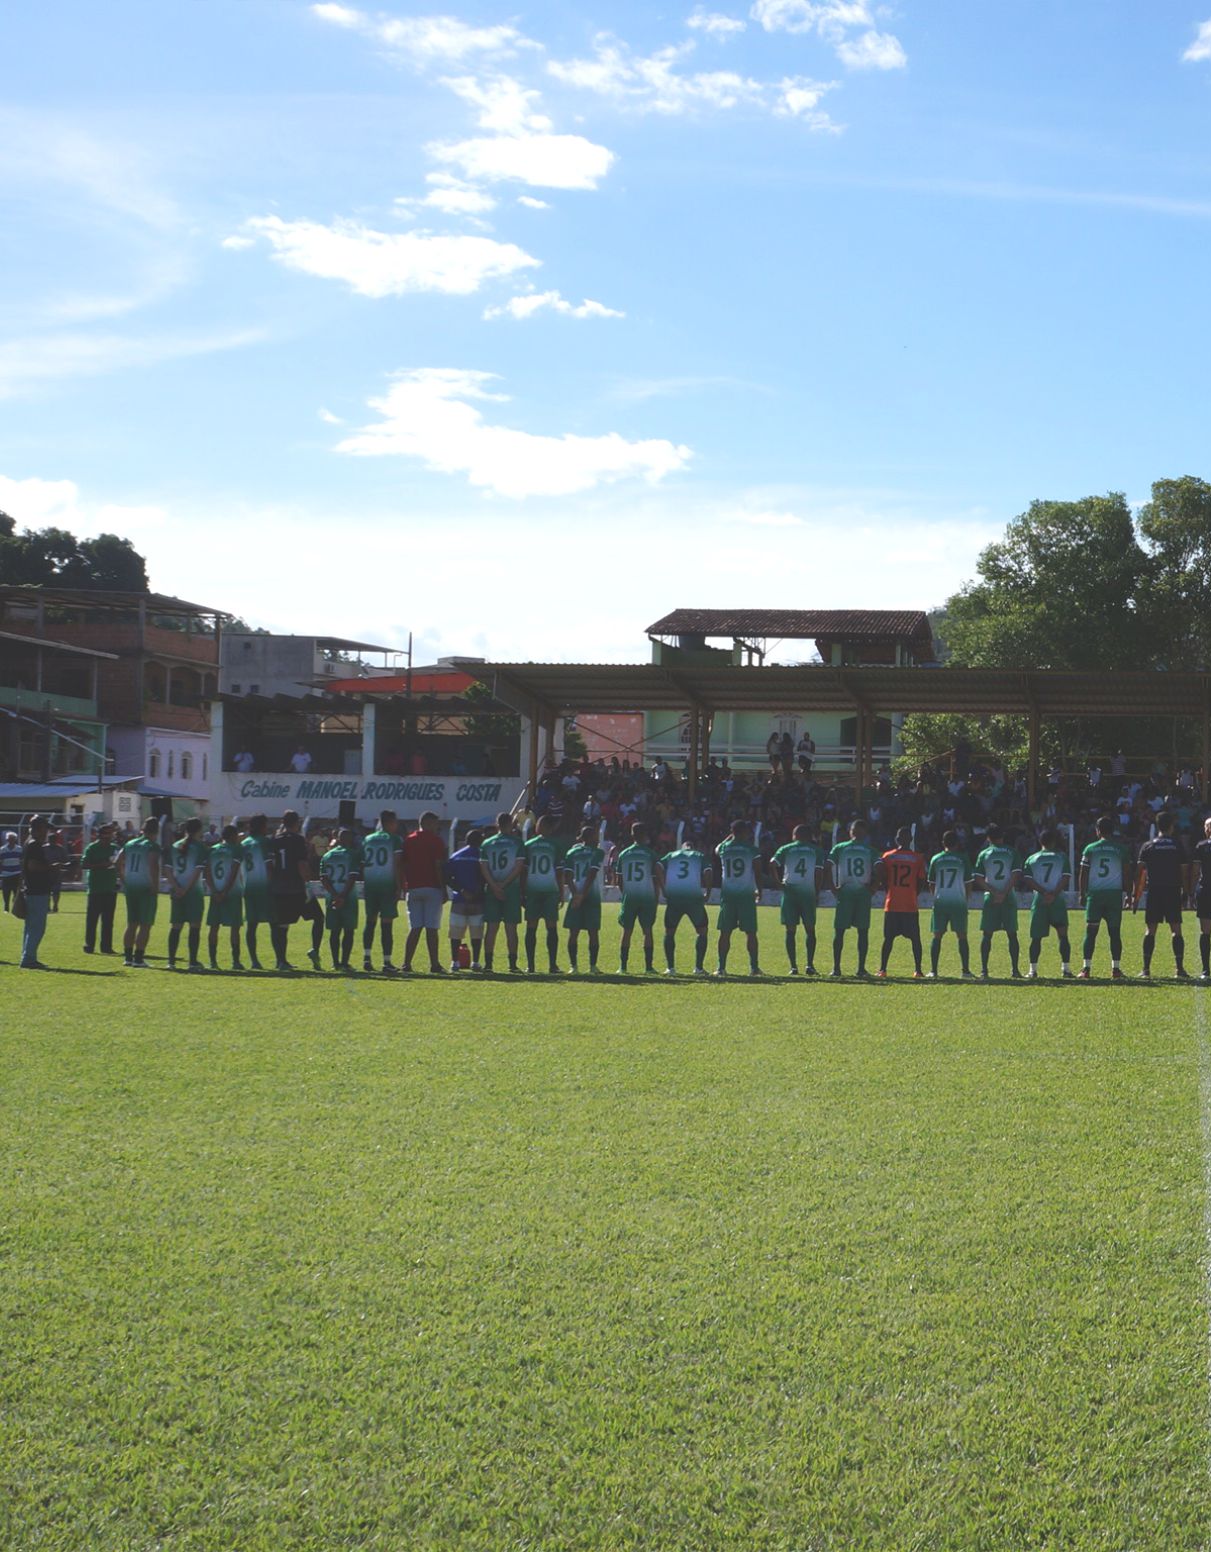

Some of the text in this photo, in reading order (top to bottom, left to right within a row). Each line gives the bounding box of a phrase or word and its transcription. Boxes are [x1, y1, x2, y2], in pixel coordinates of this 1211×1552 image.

[240, 779, 502, 802] Cabine MANOEL RODRIGUES COSTA
[130, 853, 142, 873] 11
[177, 856, 187, 874] 9
[279, 849, 287, 870] 1
[364, 847, 388, 867] 20
[492, 851, 508, 871] 16
[531, 854, 551, 875] 10
[214, 861, 225, 880] 6
[326, 864, 346, 884] 22
[626, 861, 645, 882] 15
[677, 860, 689, 880] 3
[726, 858, 745, 878] 19
[794, 858, 807, 878] 4
[847, 857, 865, 878] 18
[893, 864, 911, 887] 12
[993, 860, 1006, 880] 2
[1041, 862, 1054, 883] 7
[1098, 858, 1110, 878] 5
[939, 868, 958, 889] 17
